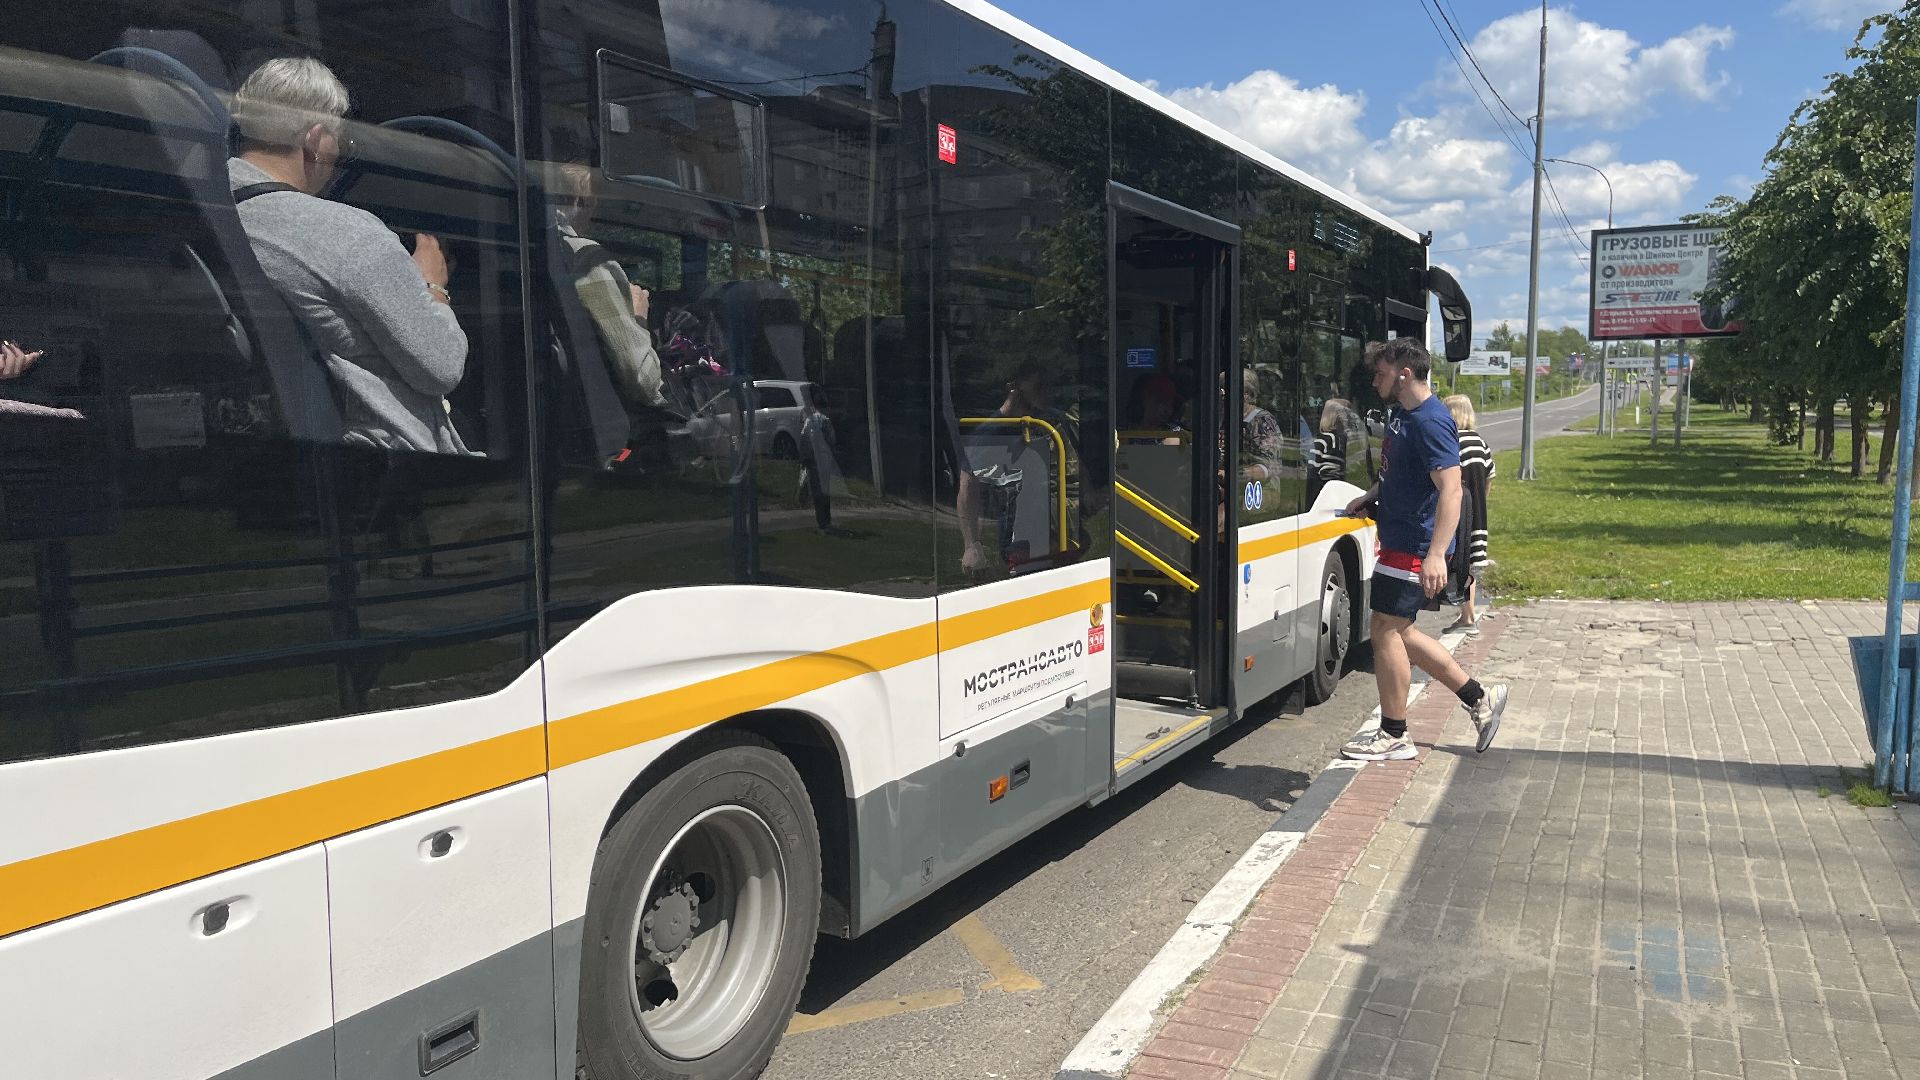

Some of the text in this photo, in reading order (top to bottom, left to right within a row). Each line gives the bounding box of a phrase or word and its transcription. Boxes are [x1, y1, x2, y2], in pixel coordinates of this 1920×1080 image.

[1602, 234, 1689, 251] ГРУЗОВЫЕ
[1601, 279, 1674, 290] от производителя
[1655, 291, 1680, 302] TIRE
[964, 640, 1083, 698] МОСТРАНСАВТО
